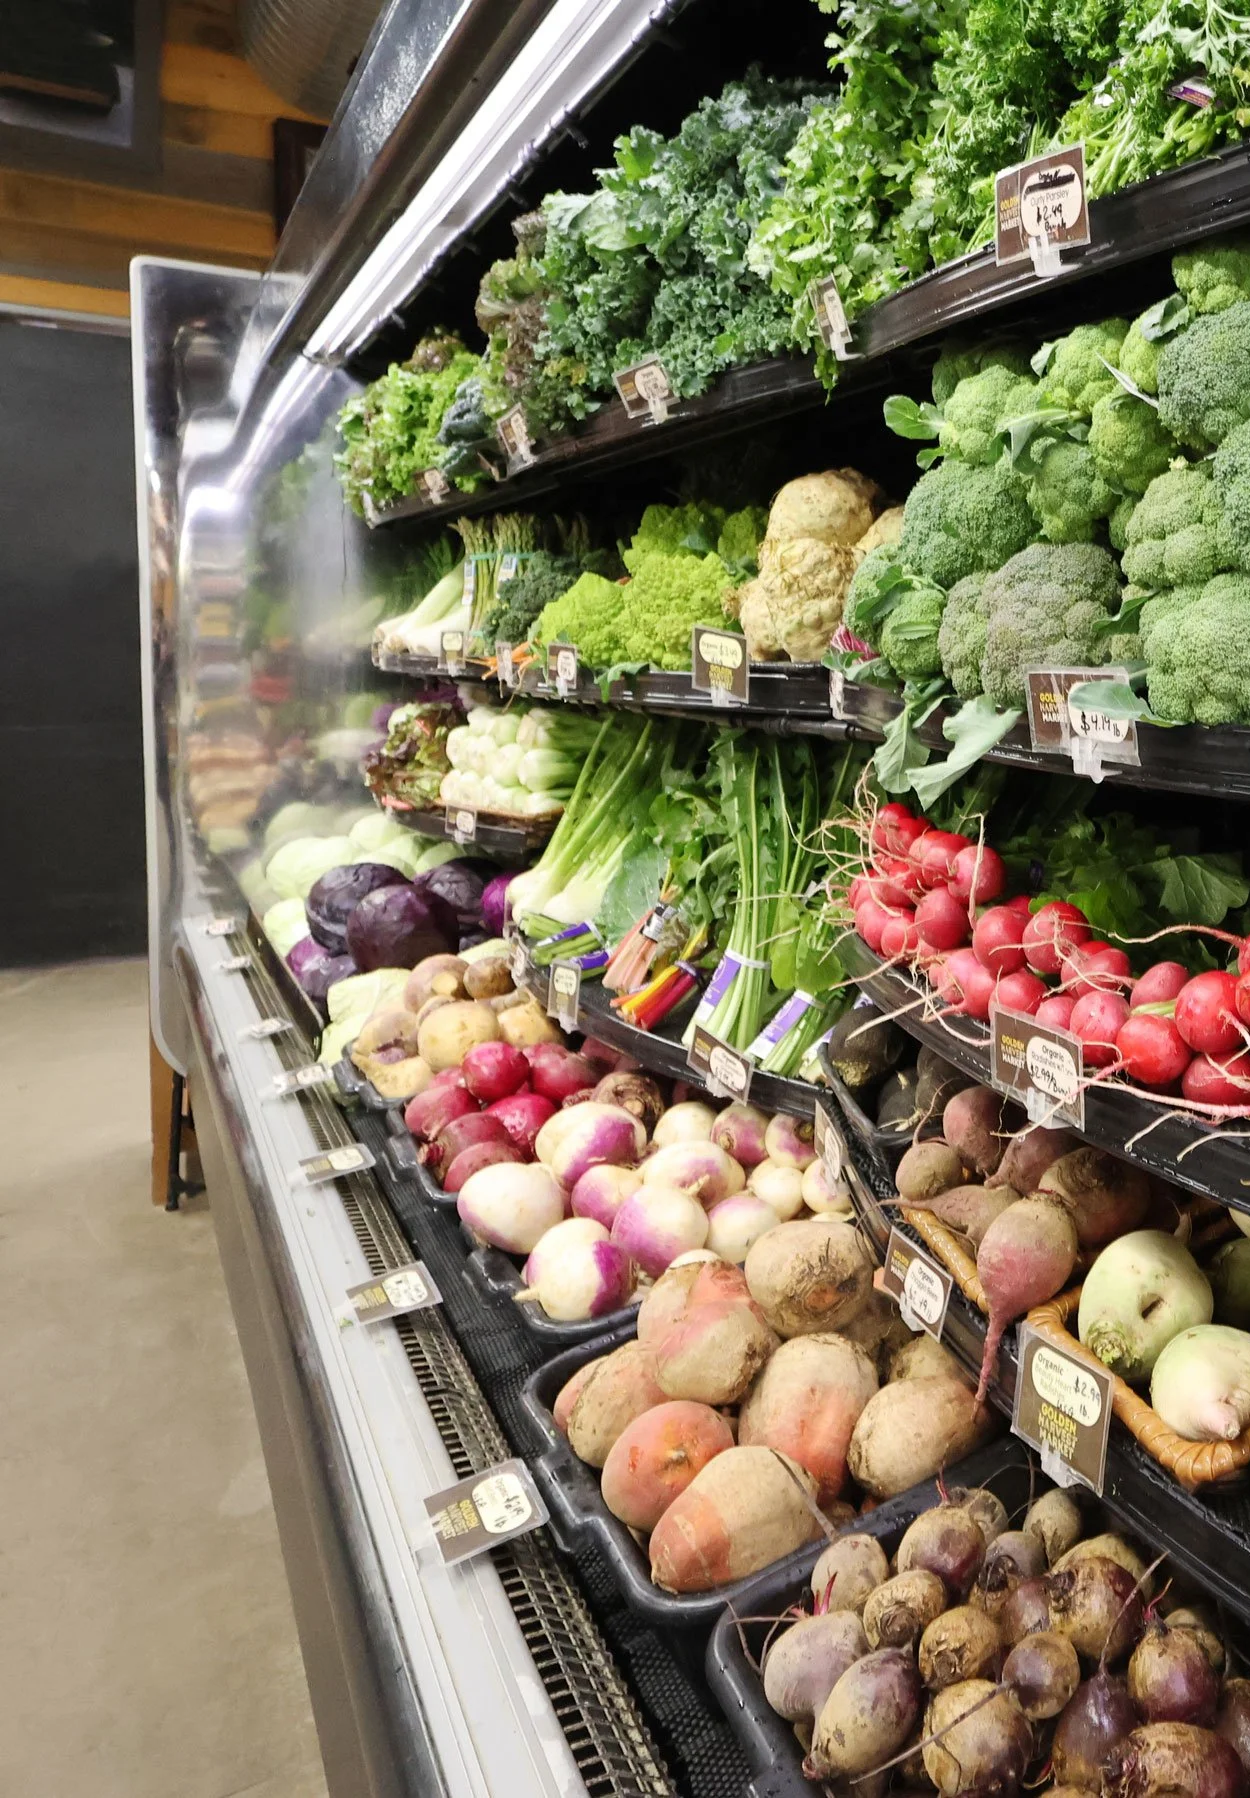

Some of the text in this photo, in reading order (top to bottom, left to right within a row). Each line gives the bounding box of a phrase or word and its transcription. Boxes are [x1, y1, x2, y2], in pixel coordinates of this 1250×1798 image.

[1046, 188, 1070, 203] Parsley
[1040, 692, 1065, 704] GOLDEN
[1002, 1035, 1025, 1051] GOLDEN
[1041, 1044, 1065, 1062] Organic
[1002, 1053, 1025, 1069] MARKET
[918, 1266, 934, 1285] Organic
[1037, 1352, 1064, 1377] Organic
[1074, 1376, 1102, 1408] $2.99
[1038, 1412, 1078, 1448] HARVEST
[1041, 1401, 1077, 1434] GOLDEN
[1039, 1427, 1075, 1461] MARKET
[447, 1503, 468, 1535] HARVEST
[459, 1499, 480, 1529] GOLDEN
